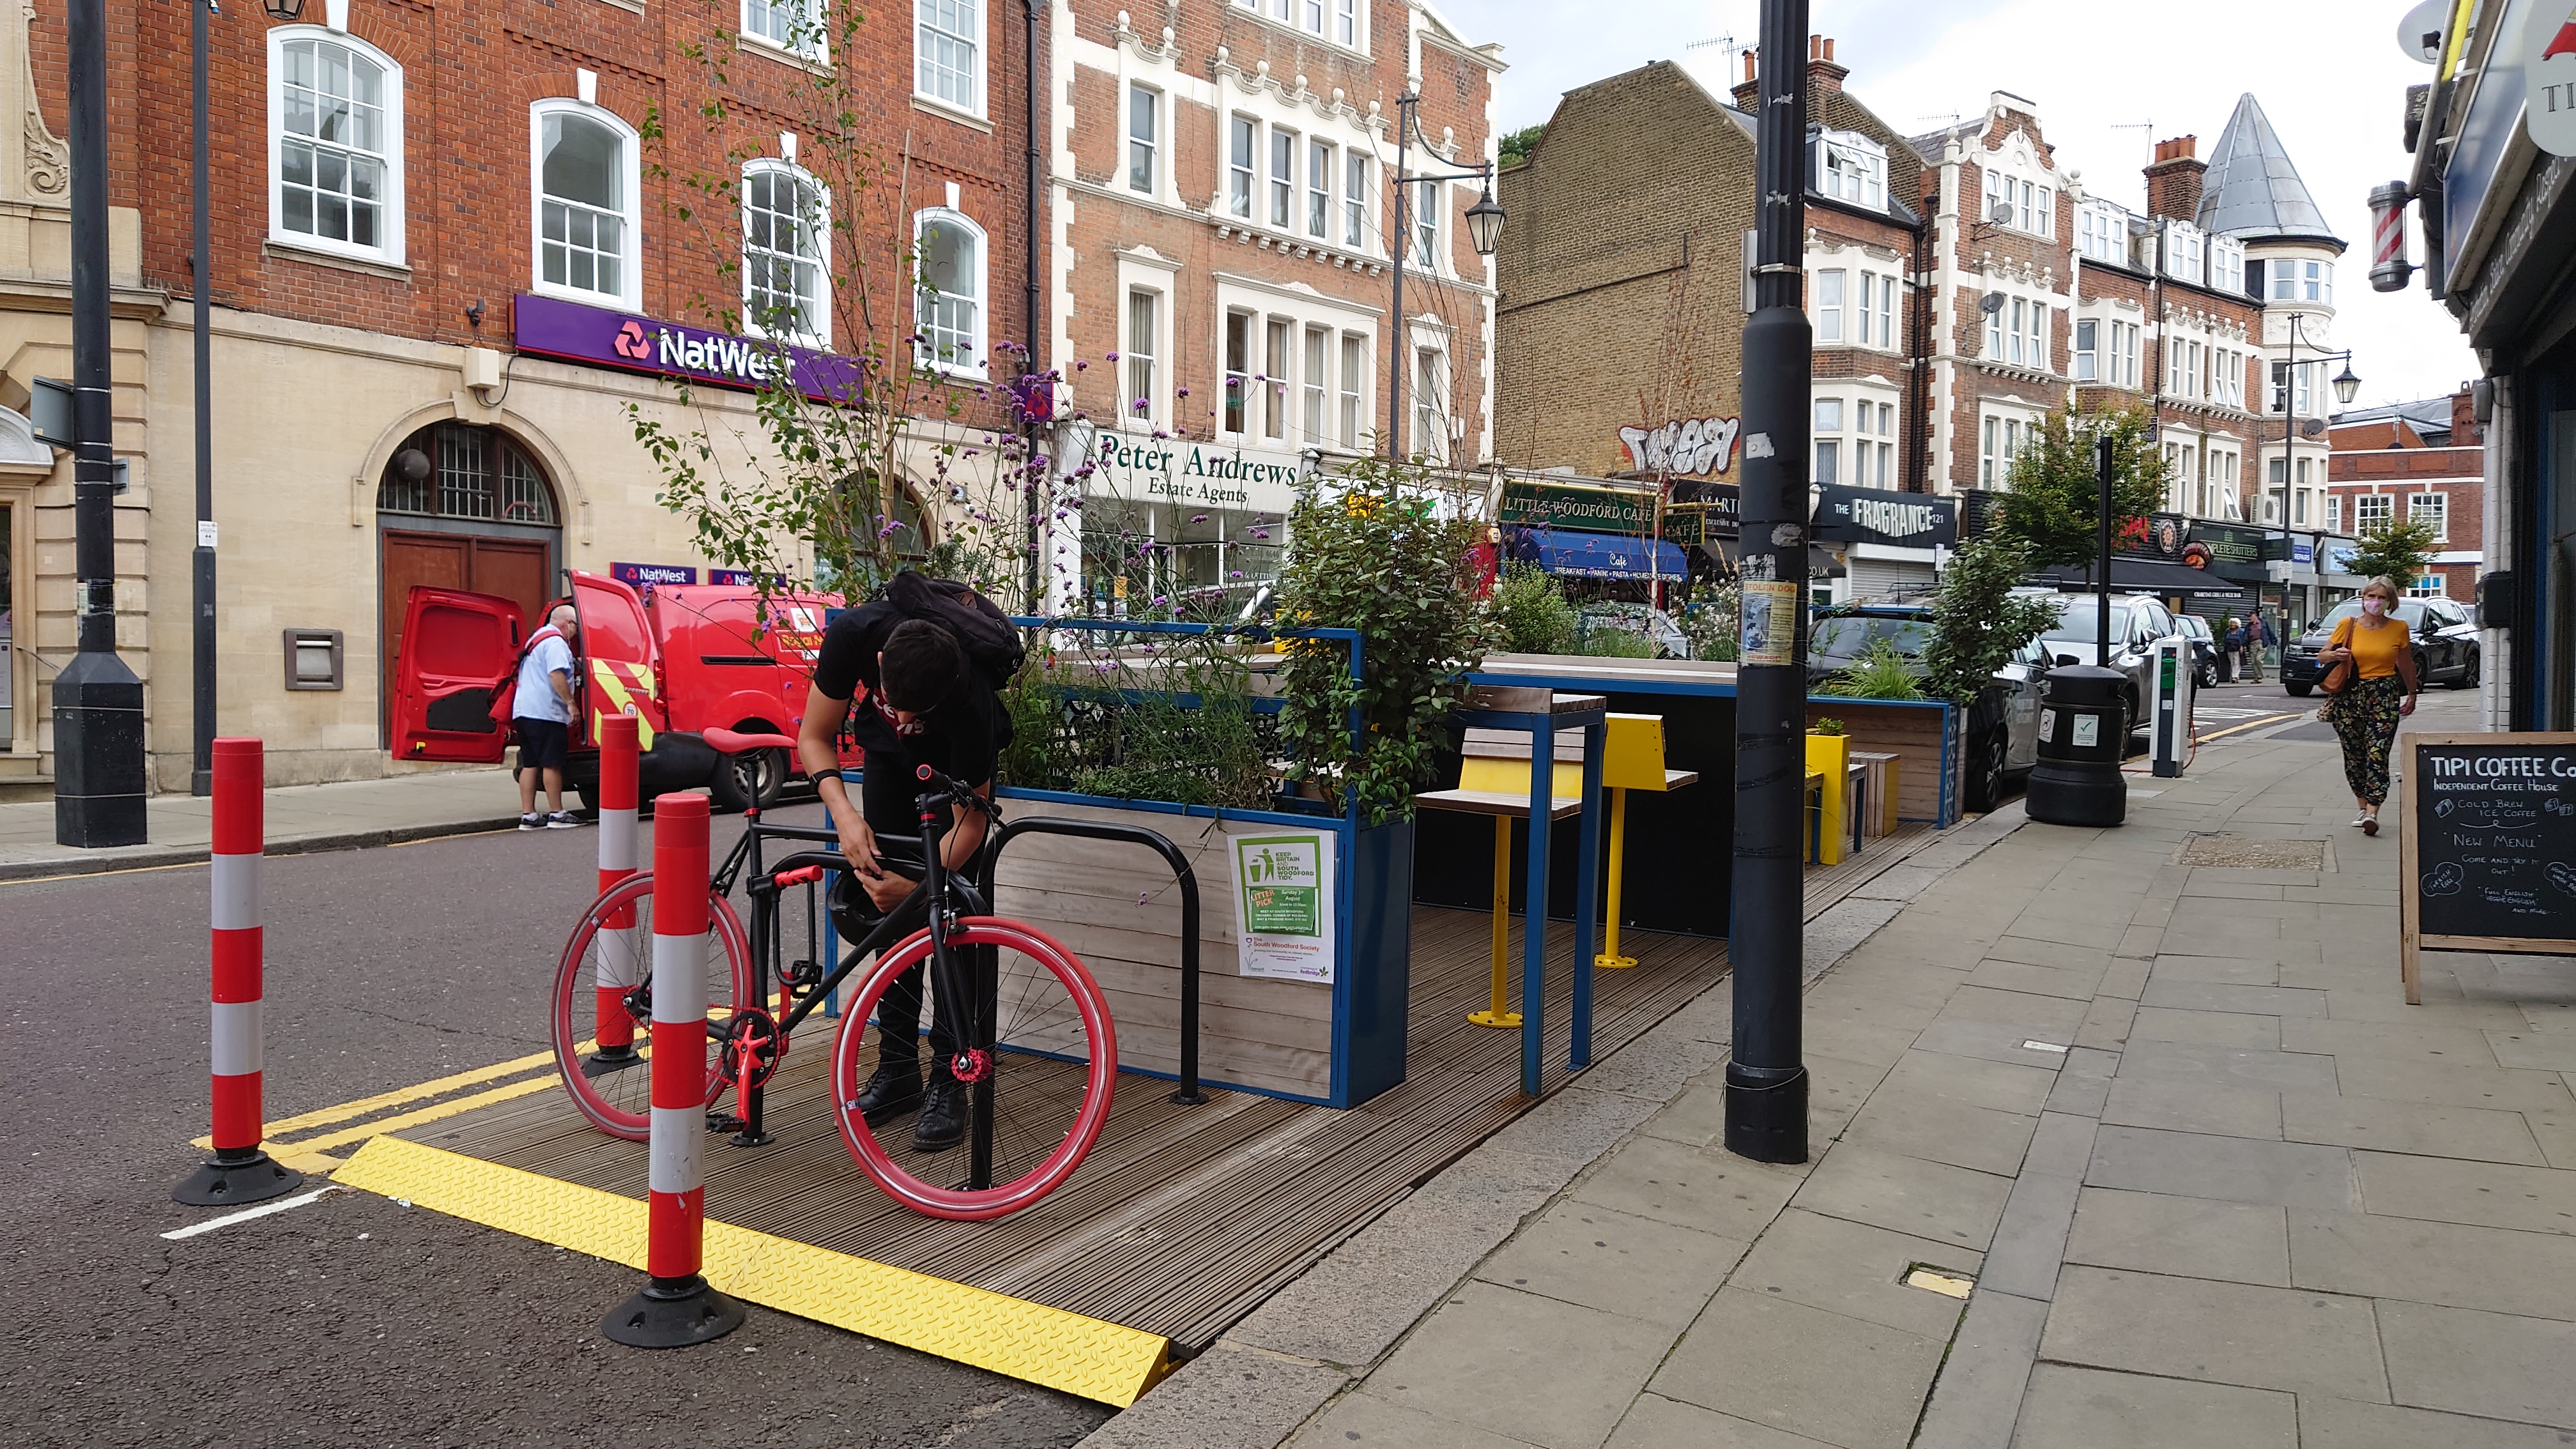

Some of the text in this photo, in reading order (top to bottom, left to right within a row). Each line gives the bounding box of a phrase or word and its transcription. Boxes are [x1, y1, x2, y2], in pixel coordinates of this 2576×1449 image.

[659, 327, 797, 386] NatWest
[1100, 434, 1296, 486] Peter Andrews
[1147, 477, 1248, 504] Estate Agents
[1504, 497, 1652, 522] LITTLE WOODFORD CAFÉ
[1834, 503, 1850, 515] THE
[1852, 498, 1934, 537] FRAGRANCE
[1931, 514, 1943, 524] 121
[1665, 520, 1699, 537] CAFÉ
[1609, 553, 1627, 569] Café
[640, 567, 686, 583] NatWest
[1554, 567, 1586, 576] BREAKFAST
[1777, 585, 1795, 593] DOG
[2430, 756, 2471, 777] TIPI
[2474, 756, 2546, 778] COFFEE
[2457, 799, 2523, 808] COLD BREW
[2461, 854, 2487, 863] COME
[2511, 857, 2526, 865] TRY
[1250, 888, 1275, 901] LITTER
[2484, 887, 2534, 897] FULL ENGLISH
[1255, 897, 1274, 908] PICK
